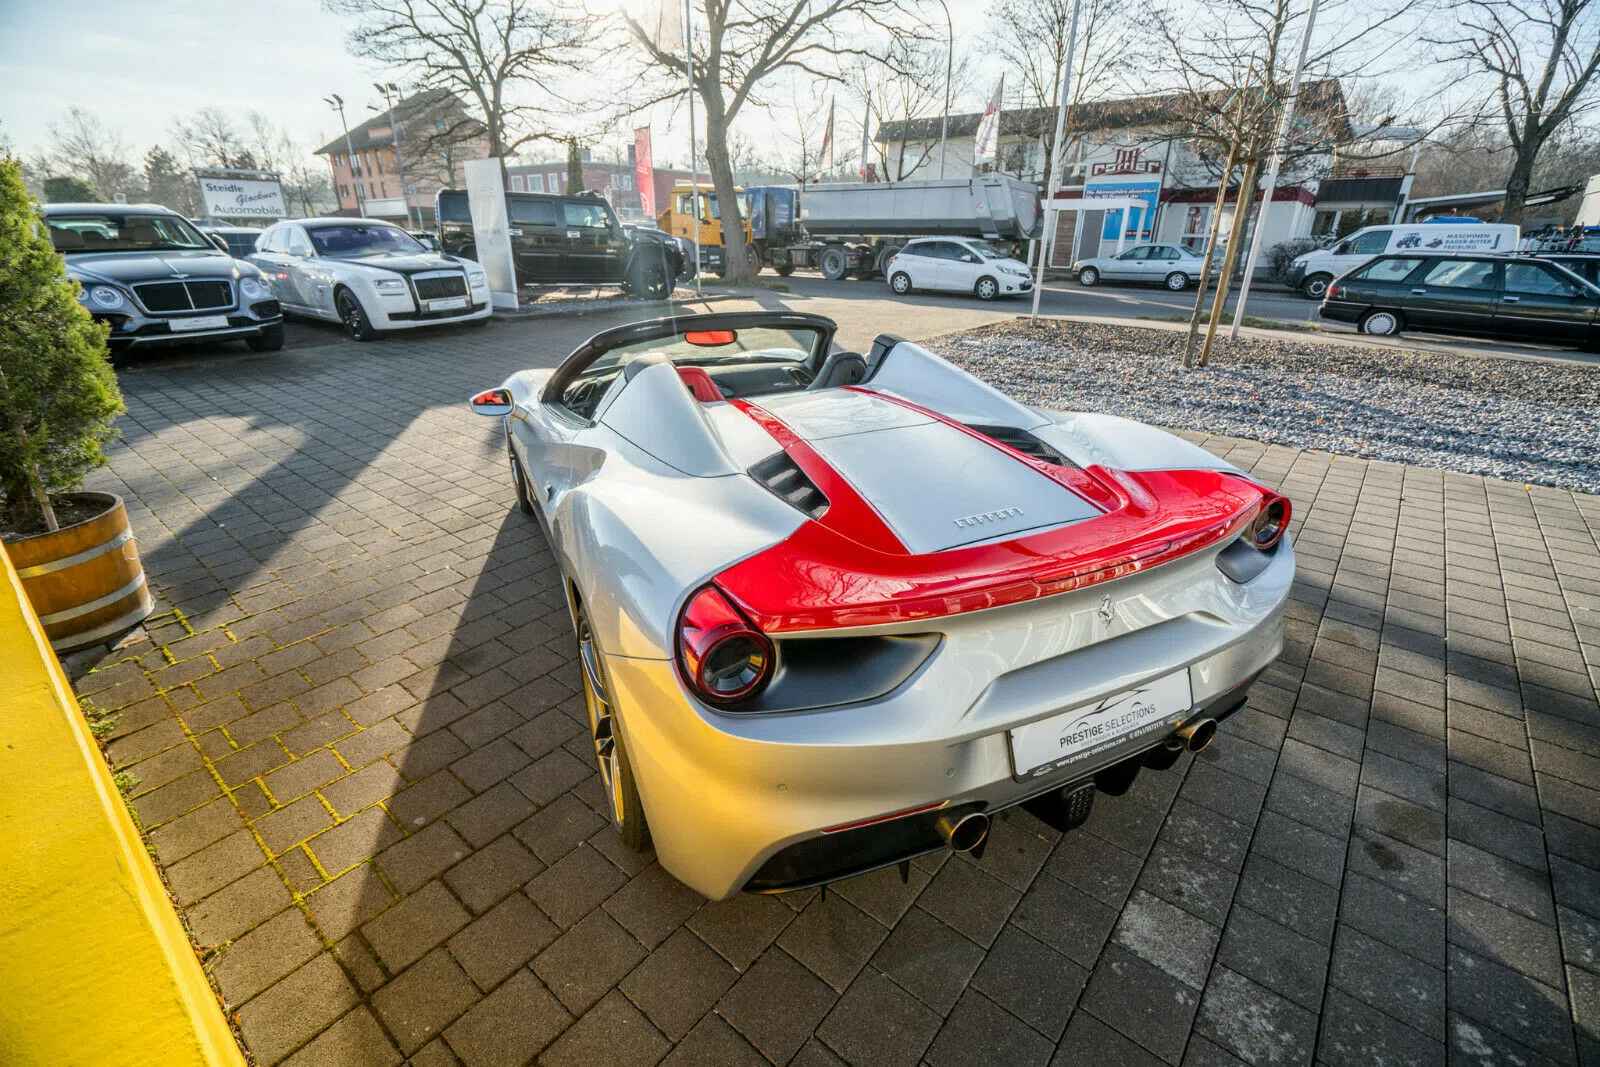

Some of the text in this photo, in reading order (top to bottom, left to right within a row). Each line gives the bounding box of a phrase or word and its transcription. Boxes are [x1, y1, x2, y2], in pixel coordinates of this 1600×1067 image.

[205, 182, 244, 193] Steidle
[213, 204, 283, 216] Automobile
[1059, 704, 1156, 749] PRESTIGE SELECTIONS
[1056, 736, 1127, 767] www.prestige-selections.com
